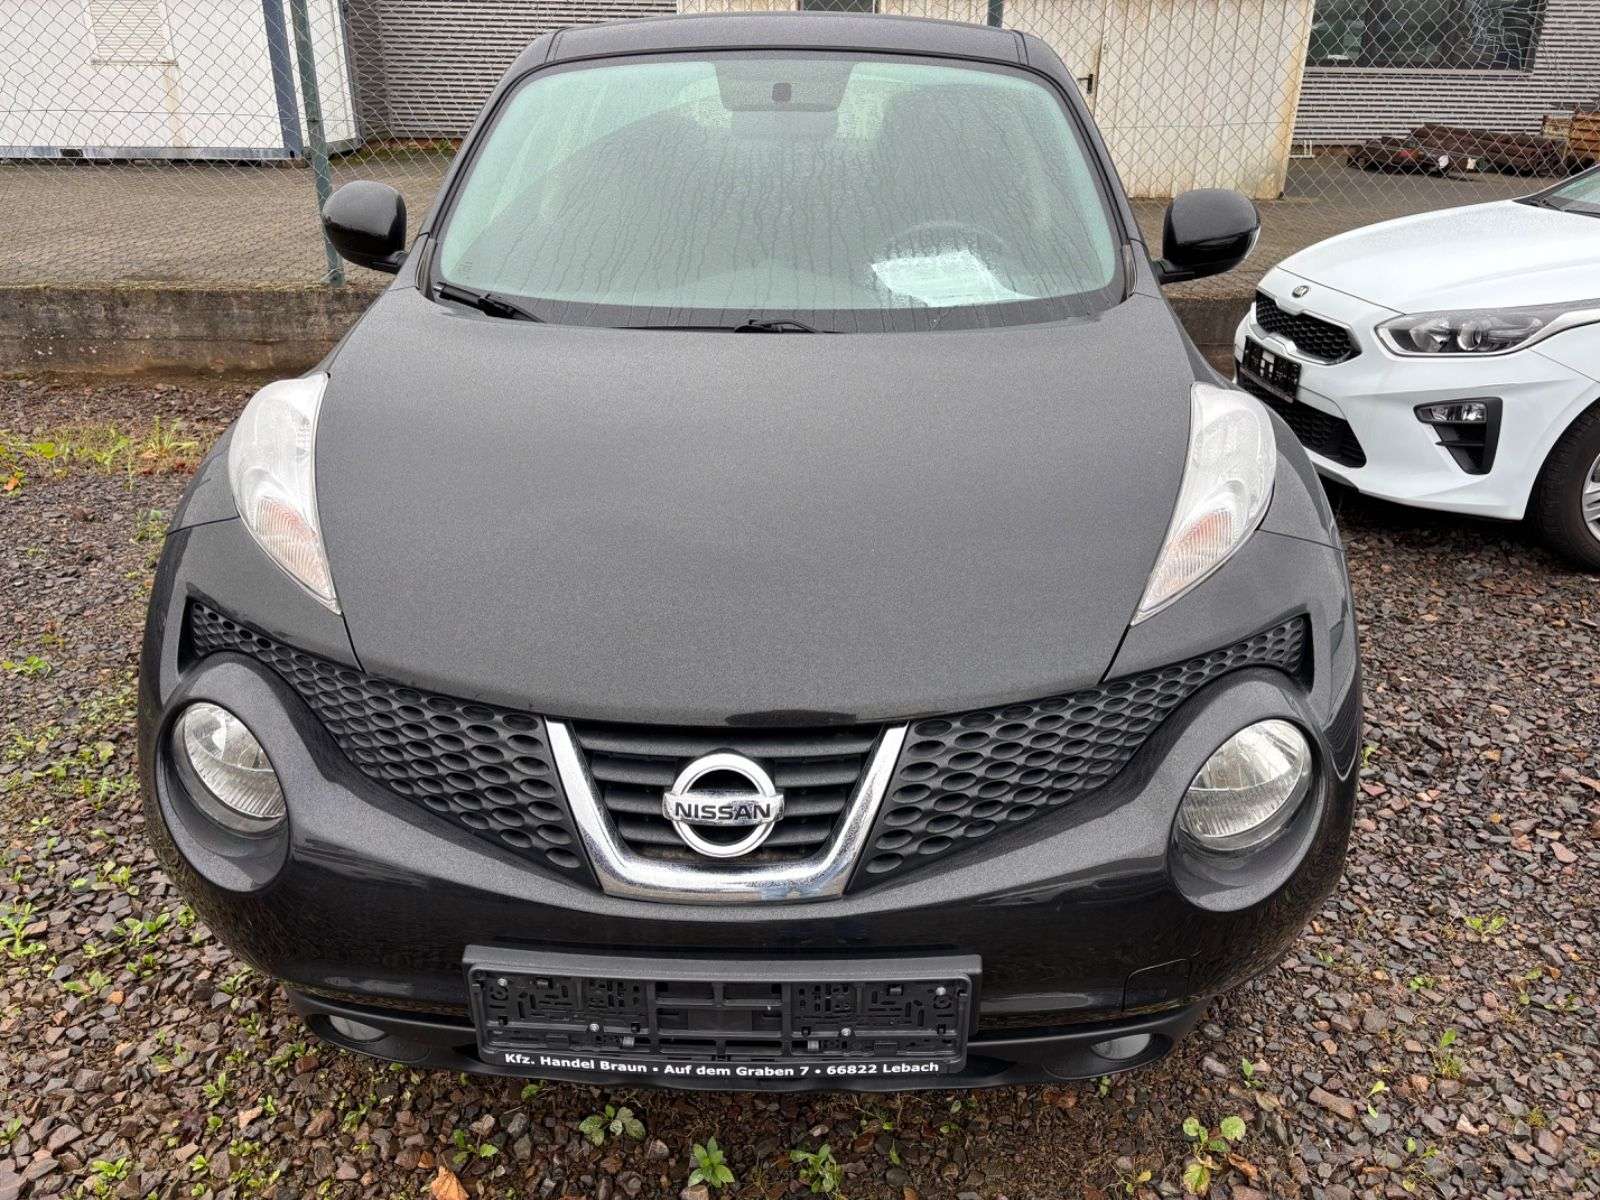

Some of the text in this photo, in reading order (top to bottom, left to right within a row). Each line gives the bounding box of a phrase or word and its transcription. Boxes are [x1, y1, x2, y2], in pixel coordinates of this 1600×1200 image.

[675, 802, 771, 820] NISSAN
[505, 1053, 939, 1077] Kfz. Handel Braun Auf dem Graben 7 66822 Lebach
